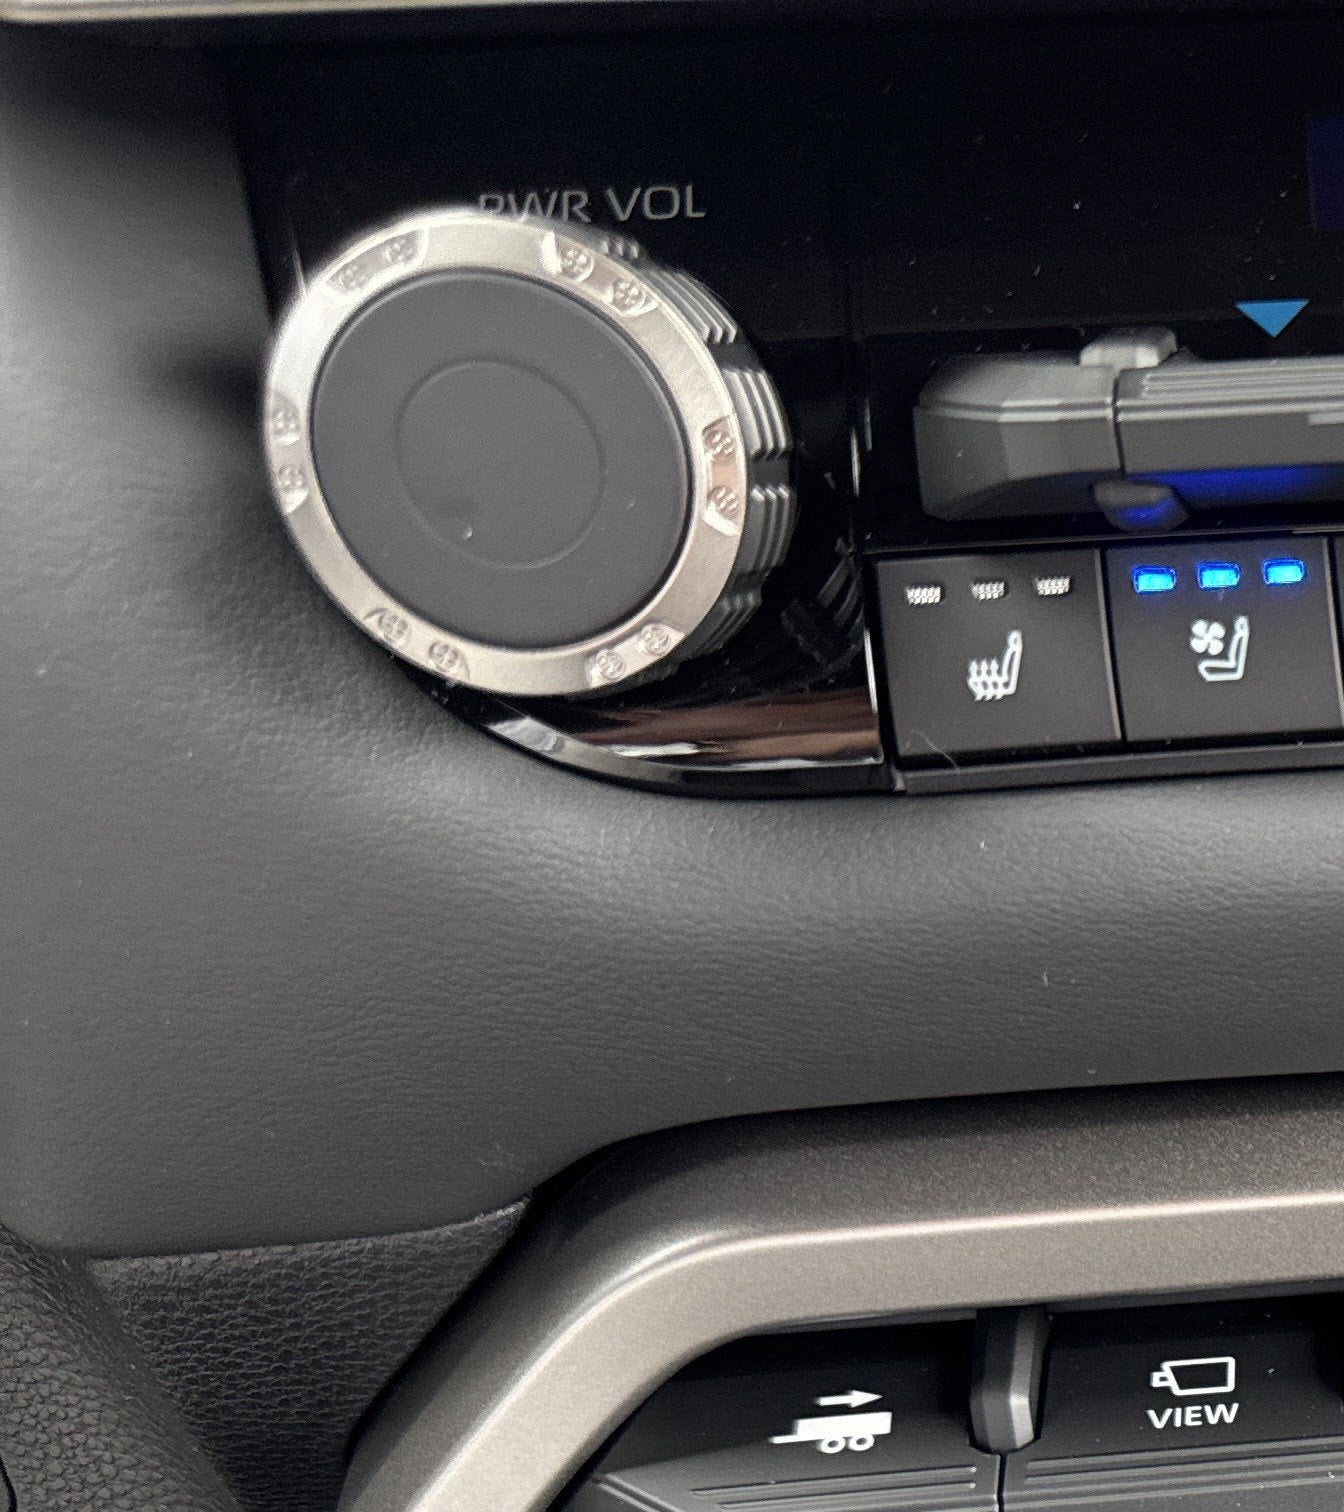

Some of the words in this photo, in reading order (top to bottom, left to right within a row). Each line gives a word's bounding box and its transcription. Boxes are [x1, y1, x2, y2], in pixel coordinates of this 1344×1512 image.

[479, 191, 592, 223] PWR
[606, 185, 707, 222] VOL
[1147, 1402, 1240, 1430] VIEW
